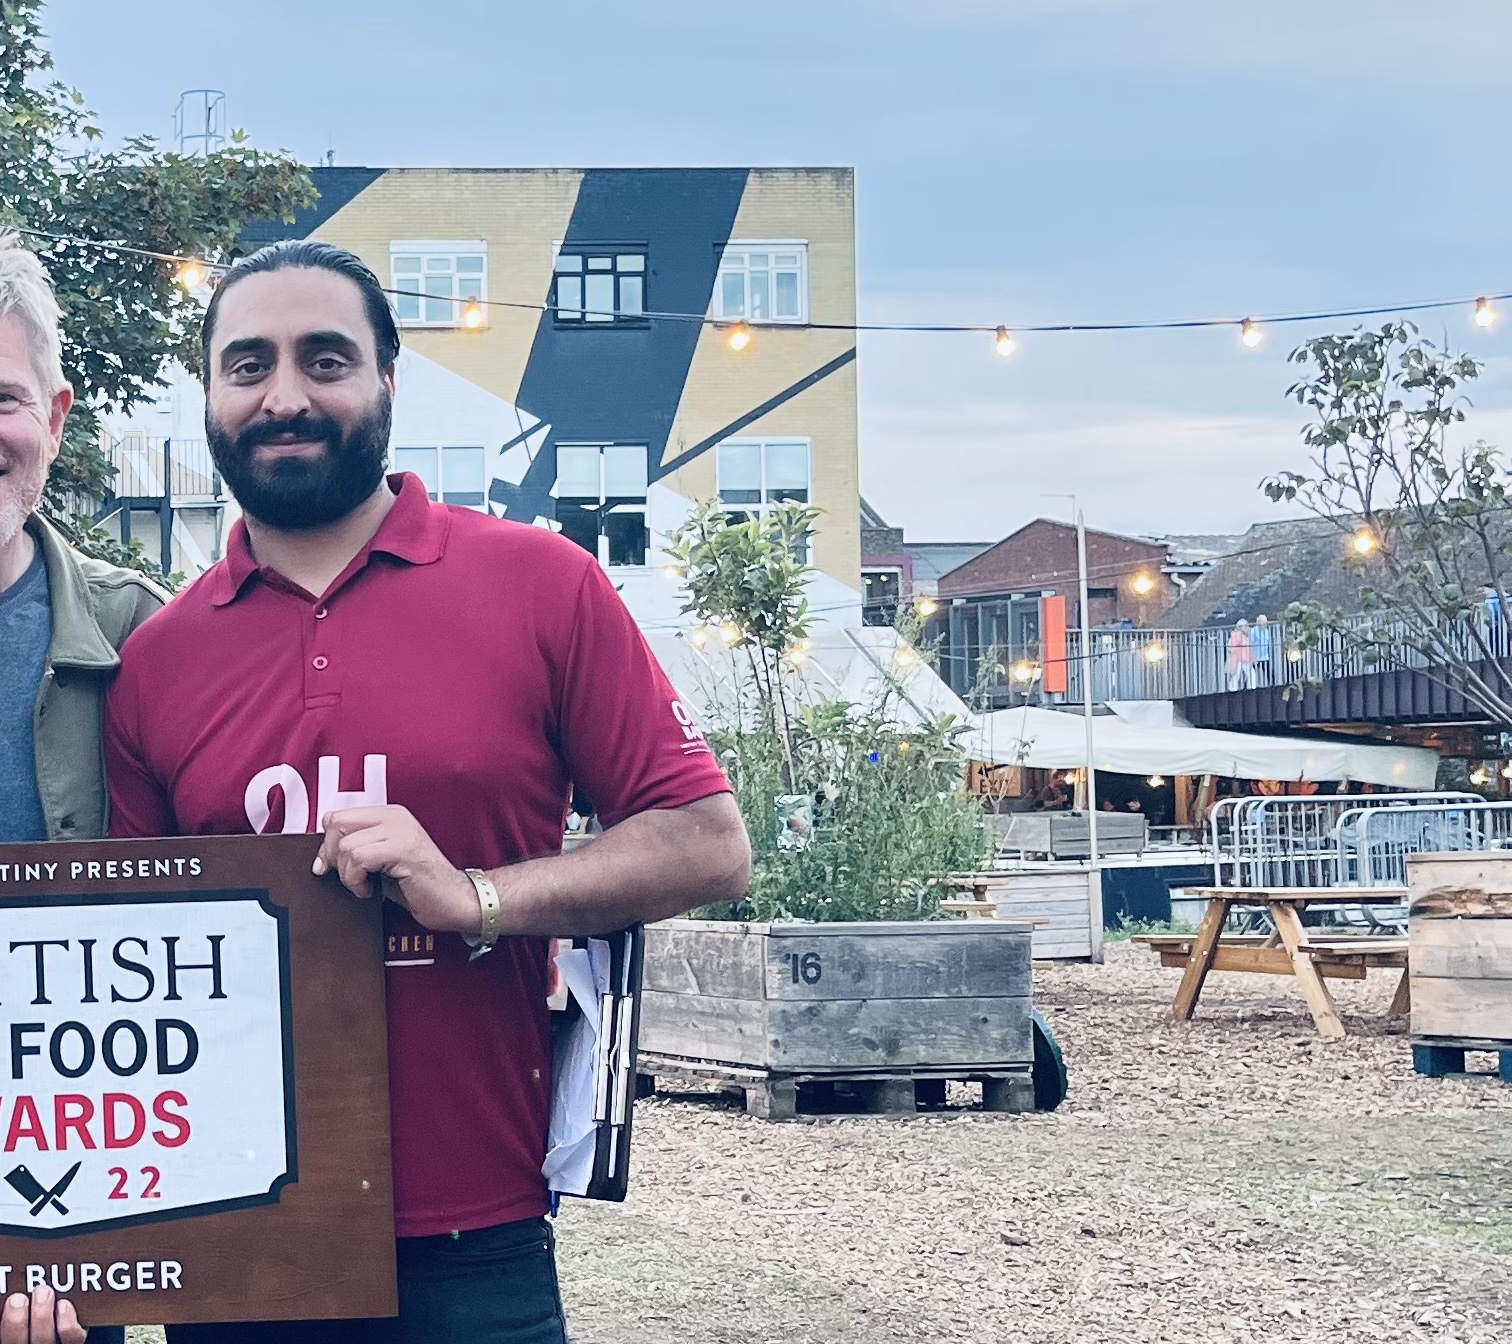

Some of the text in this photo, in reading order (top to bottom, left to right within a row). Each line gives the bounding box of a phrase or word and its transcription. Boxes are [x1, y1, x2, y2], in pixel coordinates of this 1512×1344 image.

[70, 857, 202, 880] PRESENTS
[9, 1018, 199, 1080] FOOD
[107, 1165, 162, 1200] 22
[26, 1260, 183, 1293] BURGER
